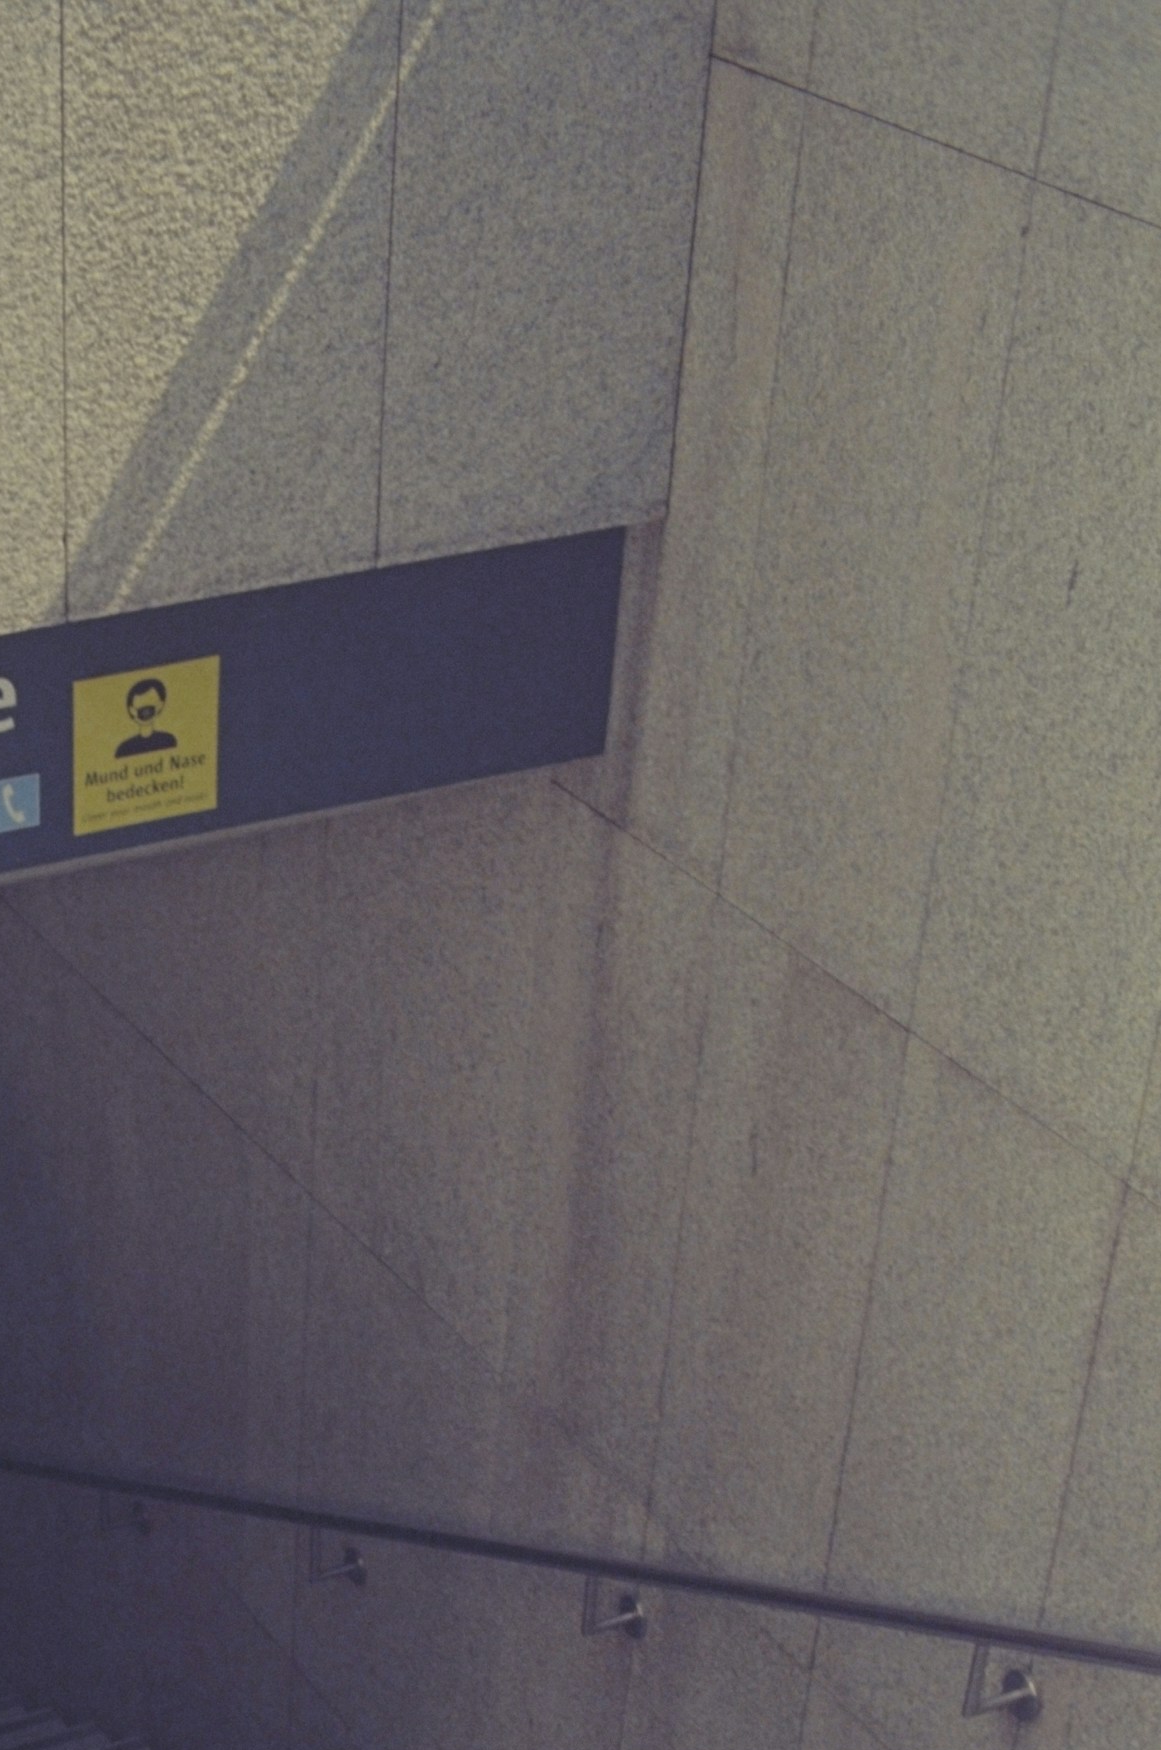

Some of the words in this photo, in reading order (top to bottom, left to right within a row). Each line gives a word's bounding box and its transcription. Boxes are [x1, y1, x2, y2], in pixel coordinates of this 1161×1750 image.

[85, 766, 129, 787] Mund
[134, 758, 164, 777] und
[170, 753, 206, 770] Nase
[106, 775, 184, 803] bedecken!
